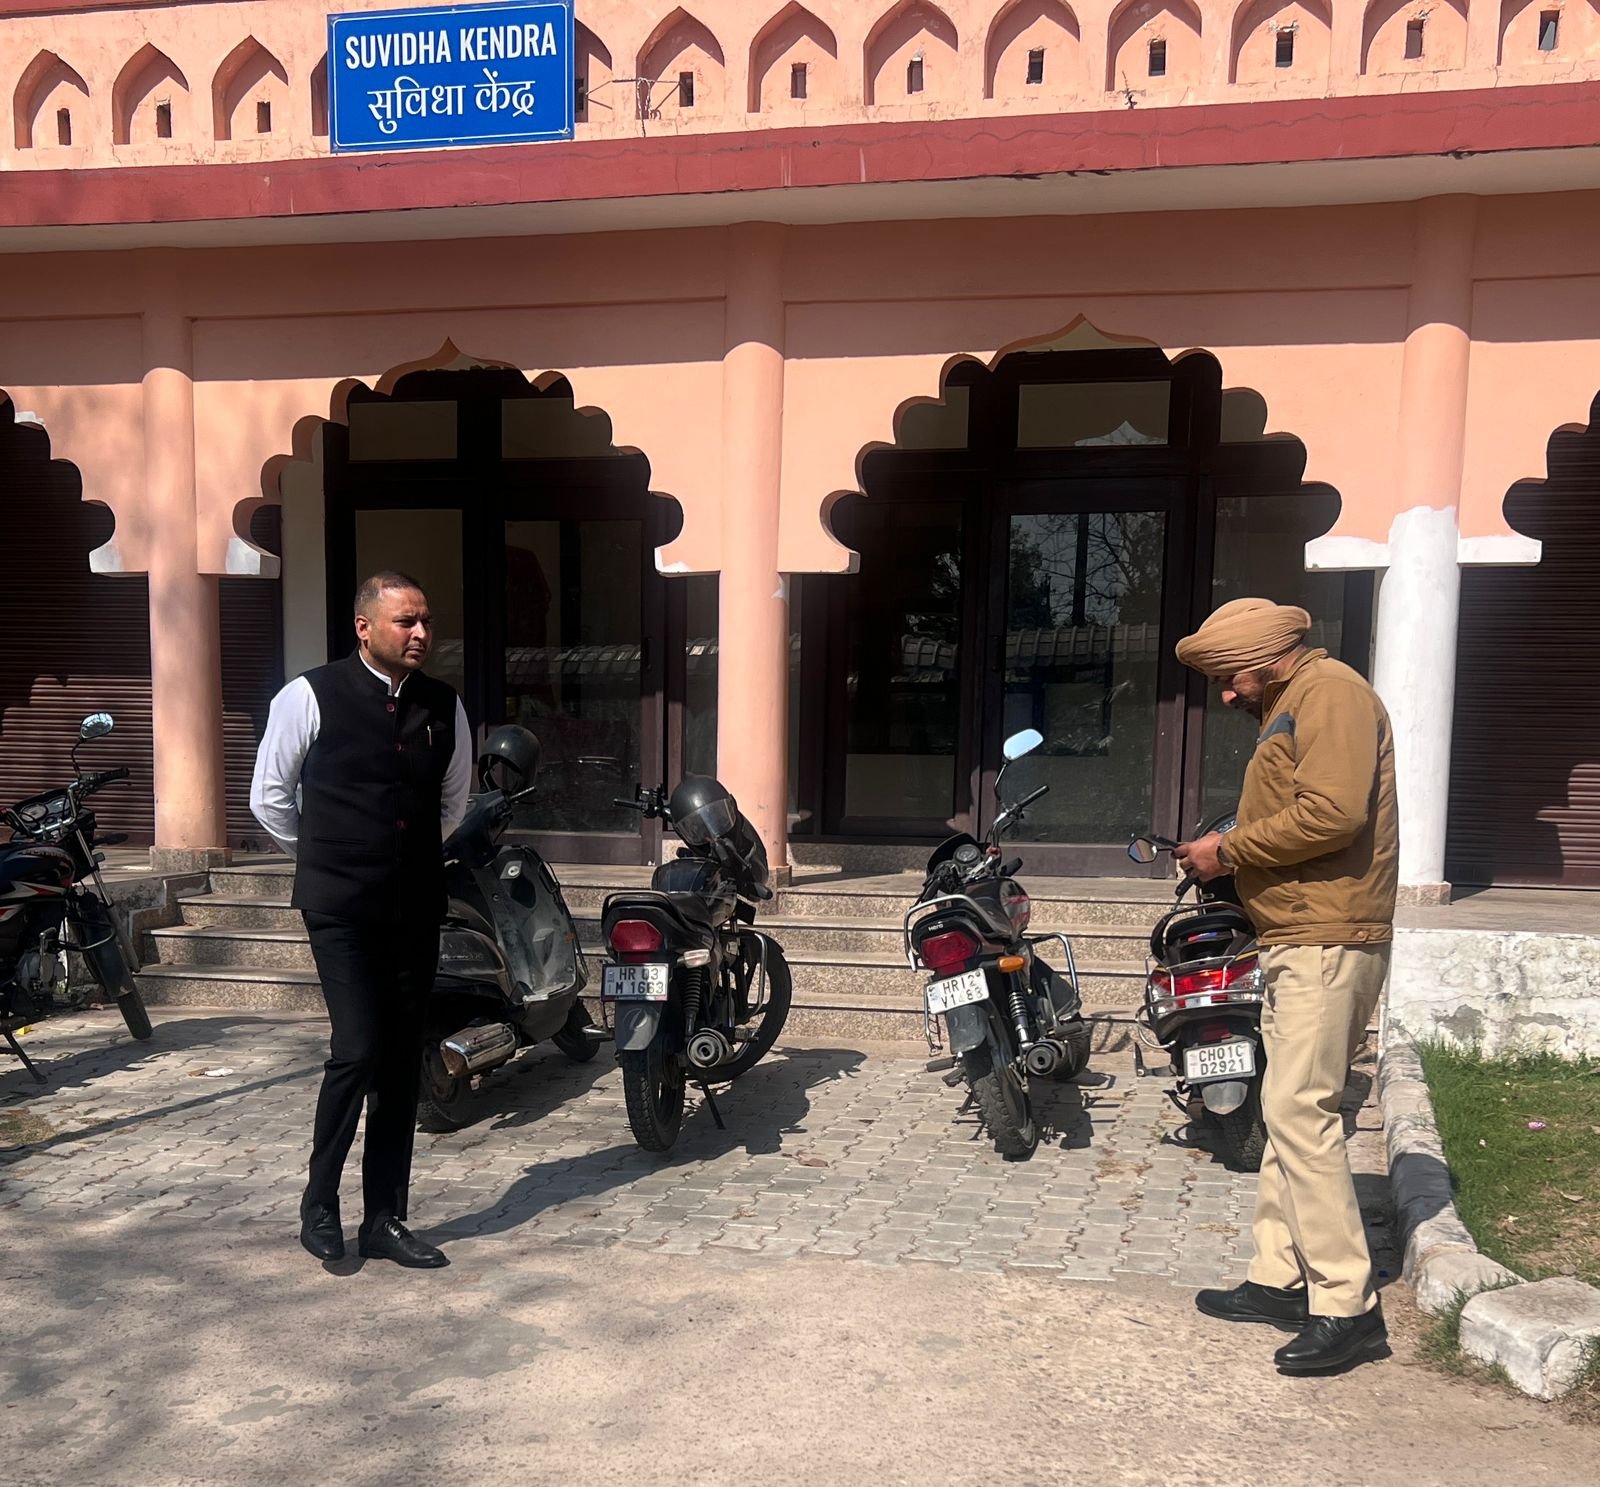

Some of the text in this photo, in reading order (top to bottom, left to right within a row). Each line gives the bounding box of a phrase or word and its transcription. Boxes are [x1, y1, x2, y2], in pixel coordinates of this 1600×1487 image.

[345, 22, 557, 70] SUVIDHA KENDRA
[366, 67, 536, 134] सुविधा केंद्र
[619, 967, 659, 980] HR 03
[615, 981, 624, 994] M
[630, 981, 664, 994] 1663
[1198, 1044, 1247, 1062] CH01C
[1200, 1058, 1245, 1075] D2921
